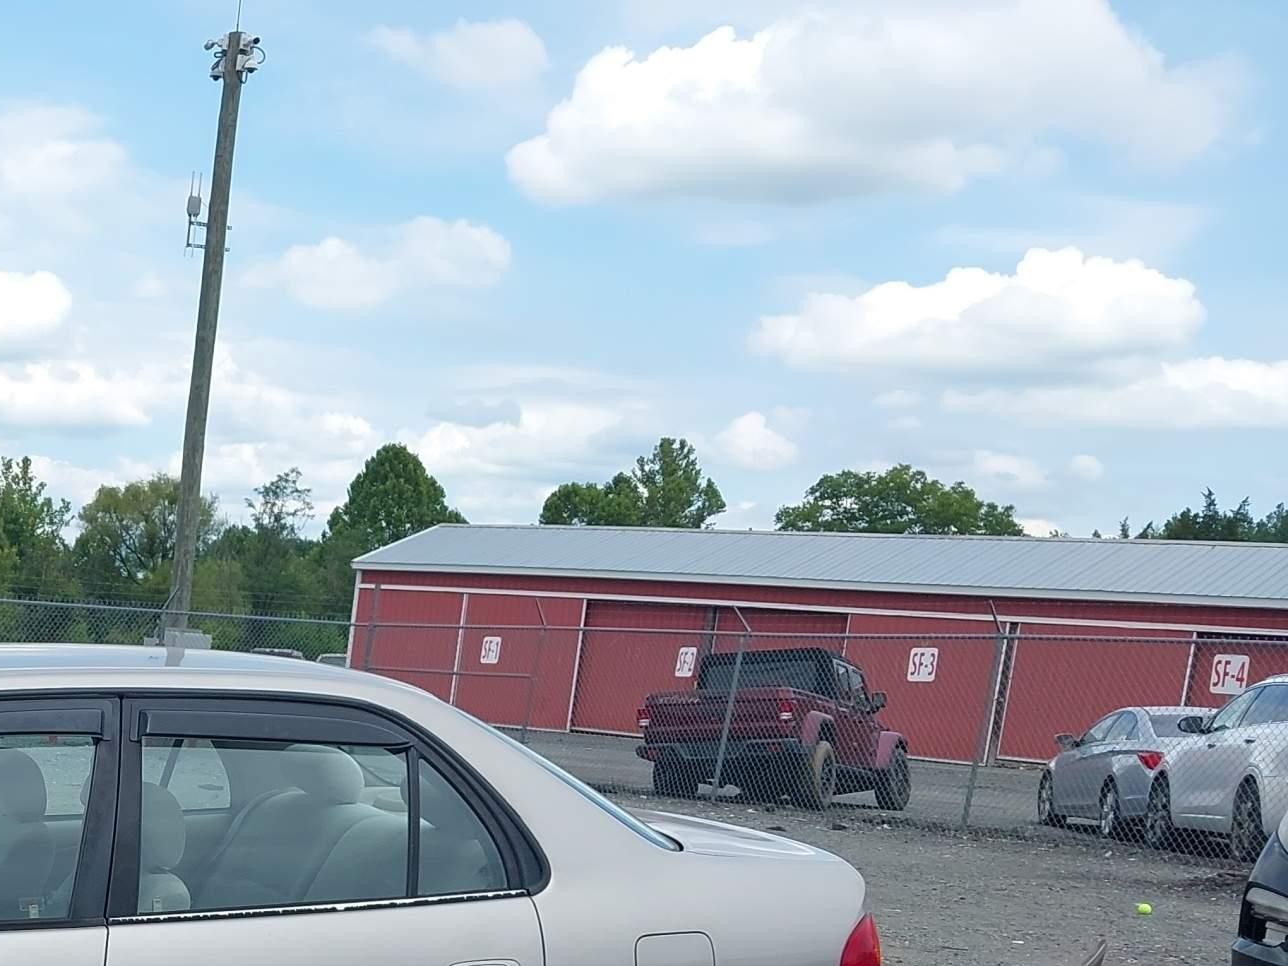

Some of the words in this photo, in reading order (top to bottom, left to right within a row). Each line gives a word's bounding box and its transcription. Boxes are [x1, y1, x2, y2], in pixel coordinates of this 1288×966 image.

[482, 640, 500, 660] SF-1
[677, 651, 695, 672] SF-2
[910, 652, 936, 676] SF-3
[1212, 660, 1246, 688] SF-4
